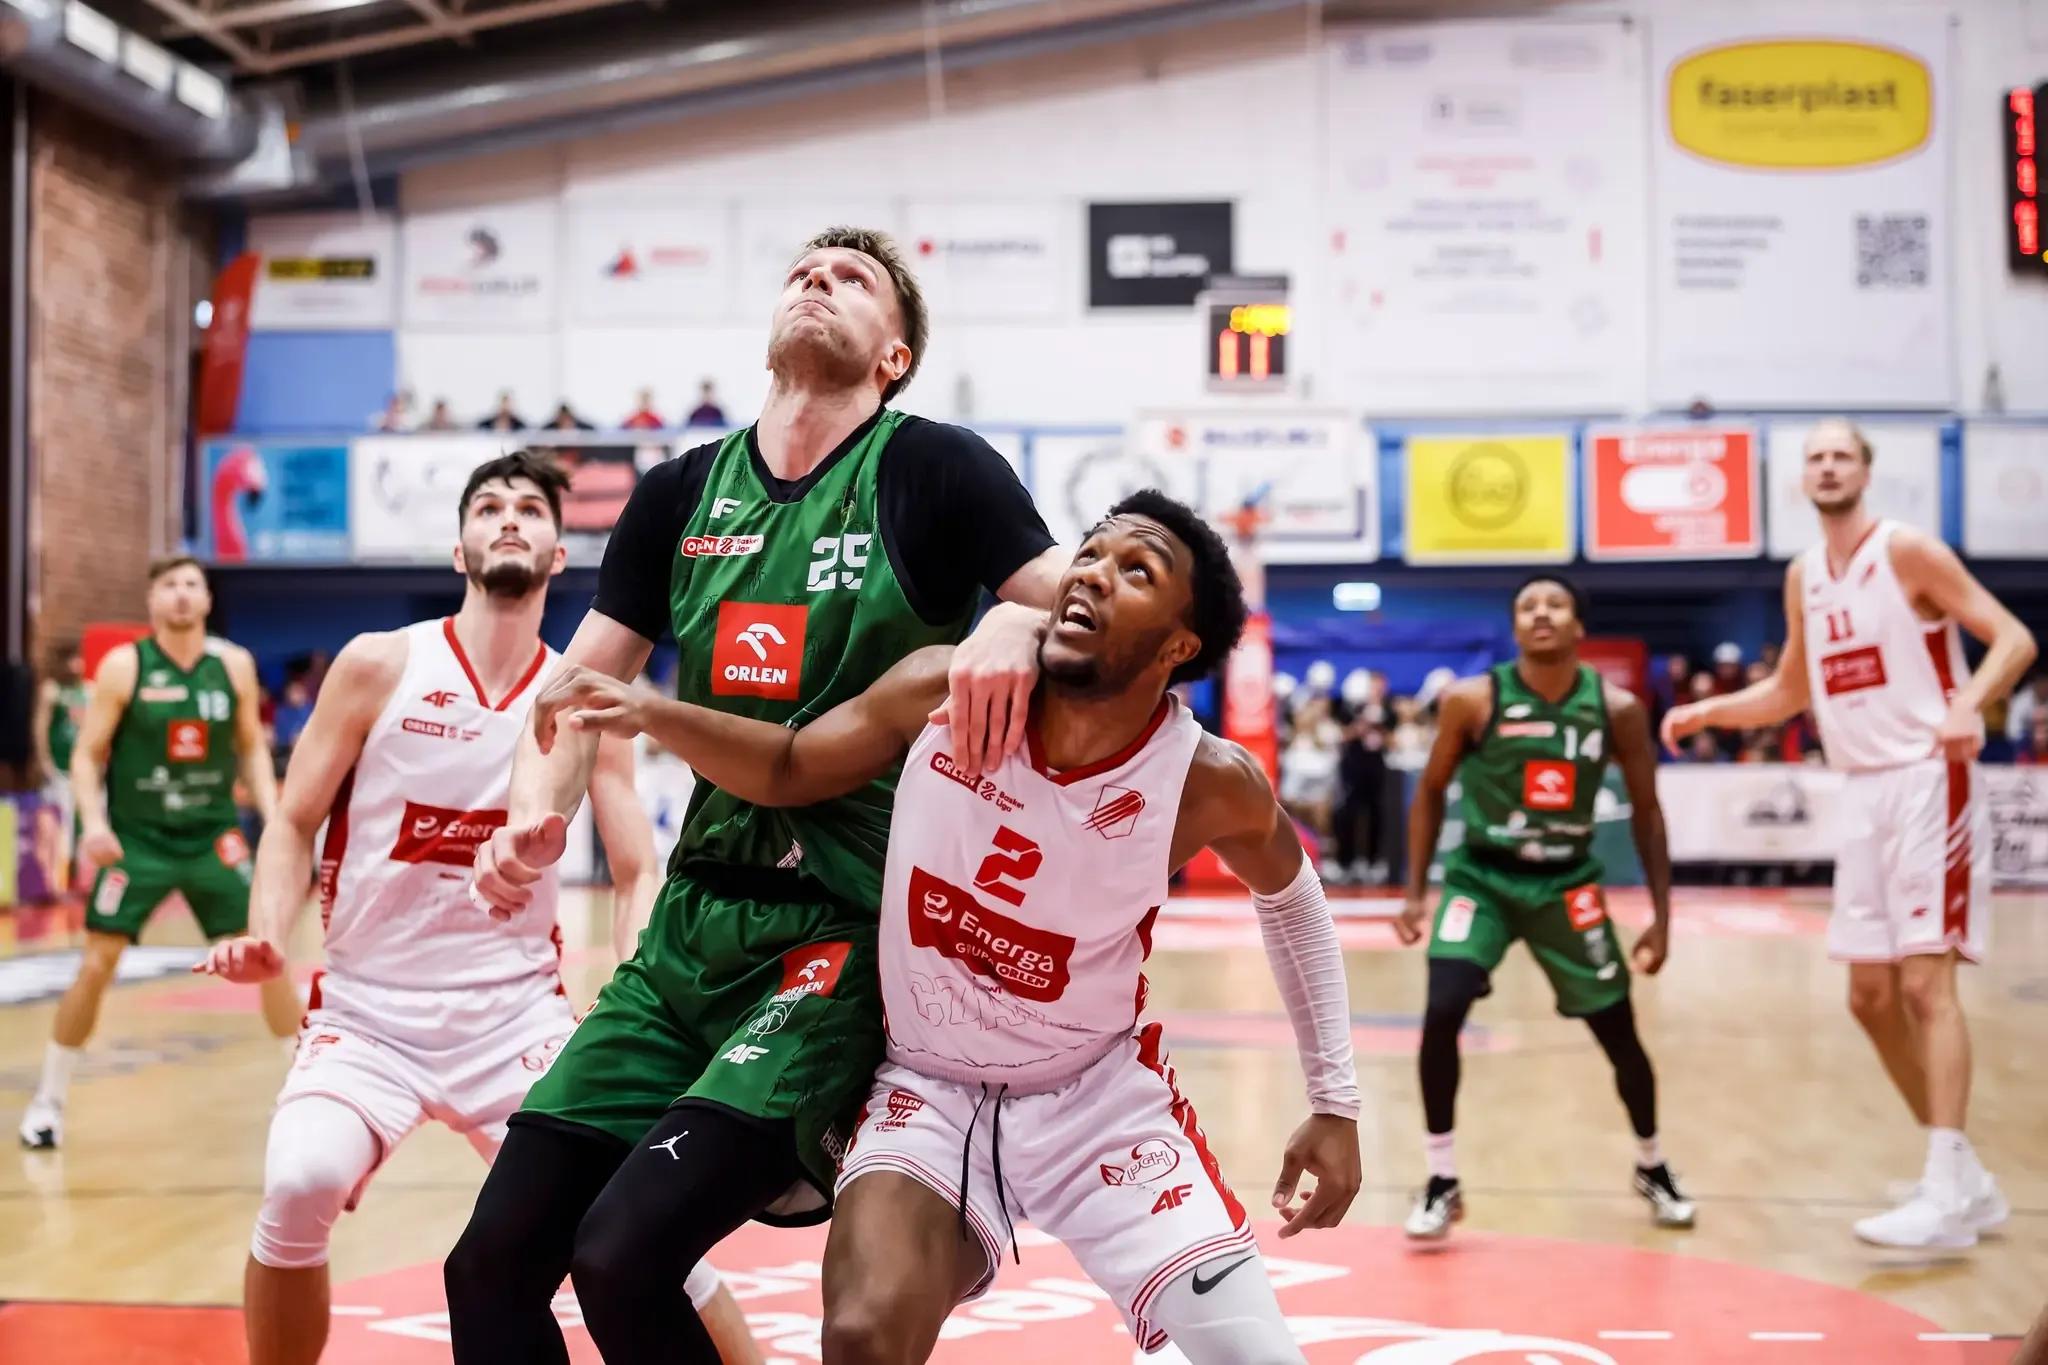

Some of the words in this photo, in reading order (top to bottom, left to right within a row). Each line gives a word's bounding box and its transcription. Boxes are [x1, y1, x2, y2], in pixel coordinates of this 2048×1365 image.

[1697, 74, 1898, 115] faserplast
[806, 533, 872, 592] 25
[1825, 609, 1856, 642] 11
[724, 664, 788, 685] ORLEN
[405, 719, 443, 735] ORLEN
[1563, 725, 1603, 762] 14
[995, 799, 1013, 813] Liga
[999, 791, 1025, 810] Basket
[441, 820, 496, 839] Ener
[972, 824, 1044, 908] 2
[958, 910, 1055, 973] Energa
[997, 965, 1047, 987] ORLEN
[782, 980, 825, 1001] ORLEN
[890, 1096, 922, 1109] ORLEN
[1126, 1150, 1172, 1181] PGH
